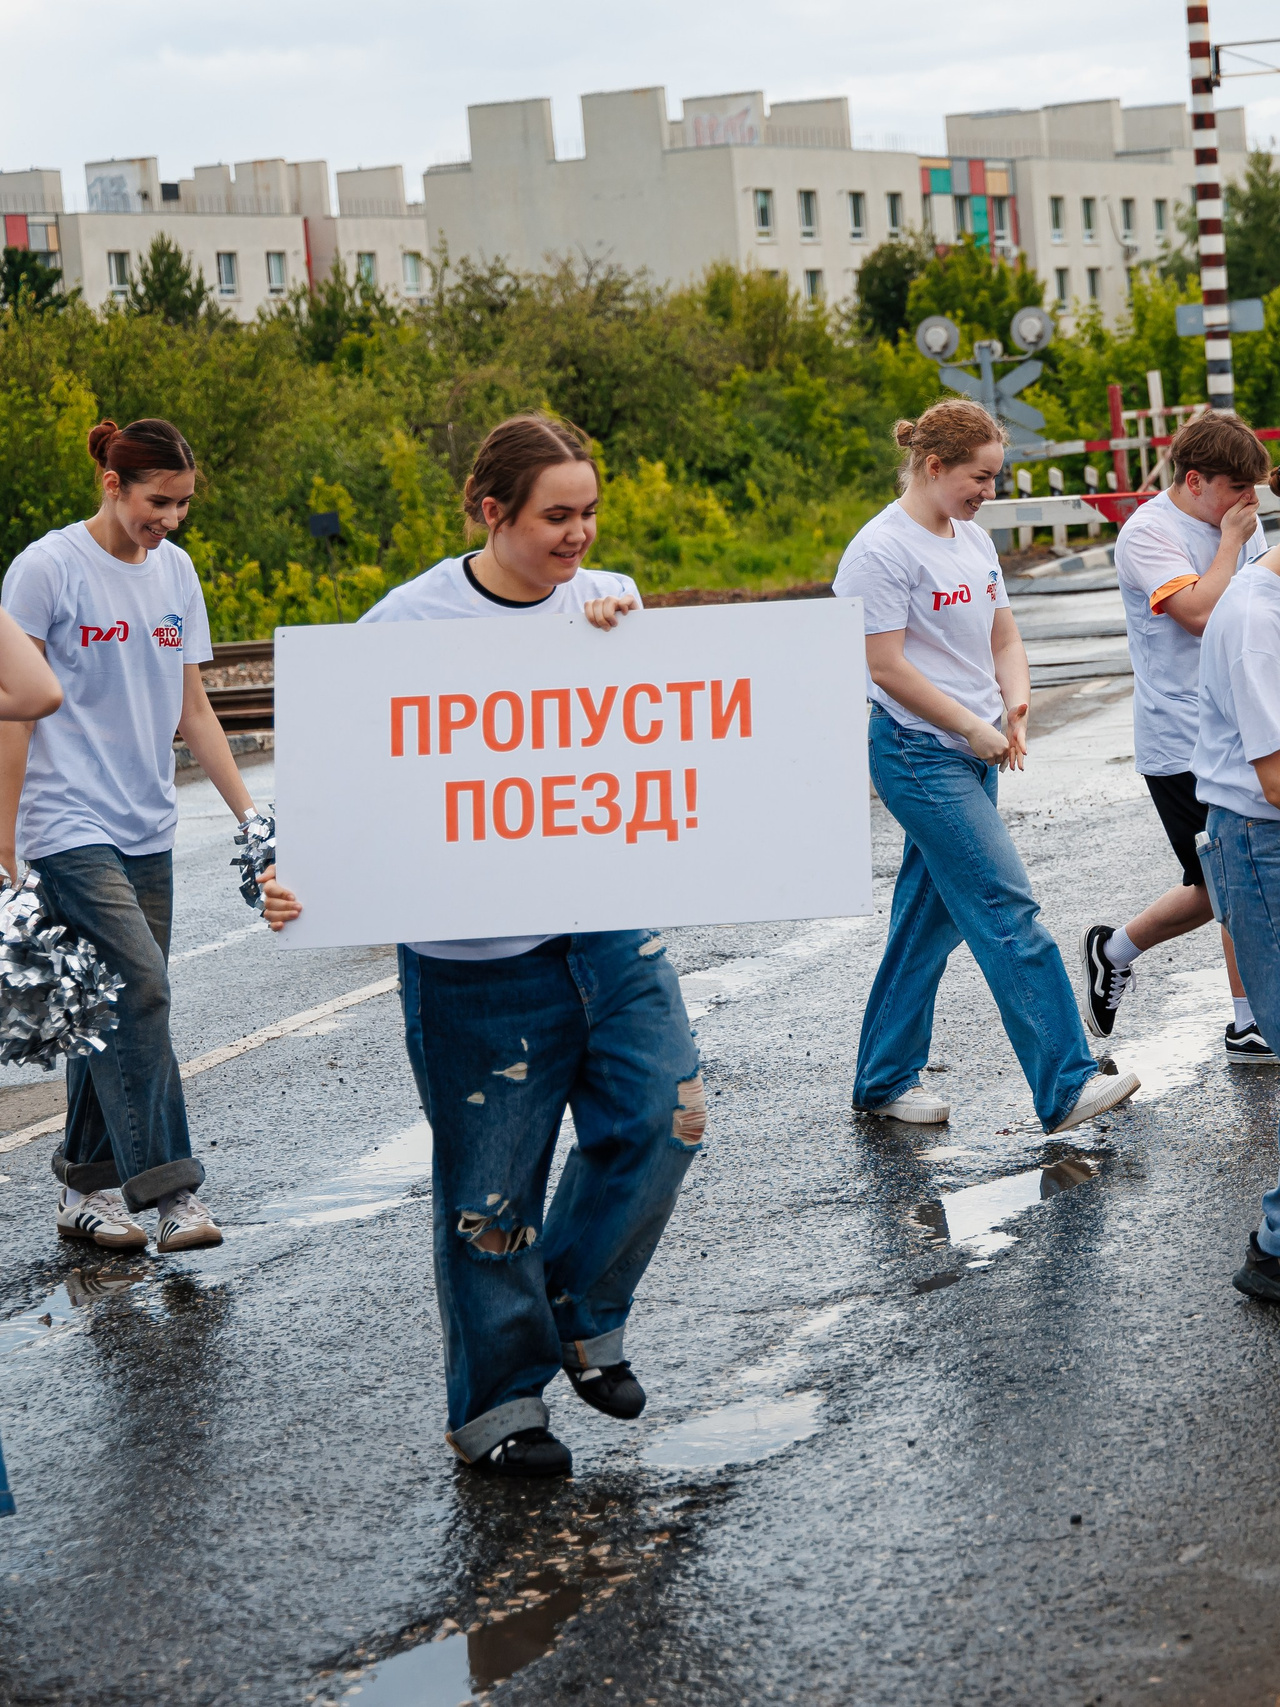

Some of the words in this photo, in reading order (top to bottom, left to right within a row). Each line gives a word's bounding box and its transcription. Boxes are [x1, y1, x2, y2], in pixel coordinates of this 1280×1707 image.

[151, 627, 178, 638] АВТО
[390, 678, 753, 757] ПРОПУСТИ
[445, 768, 699, 844] ПОЕЗД!
